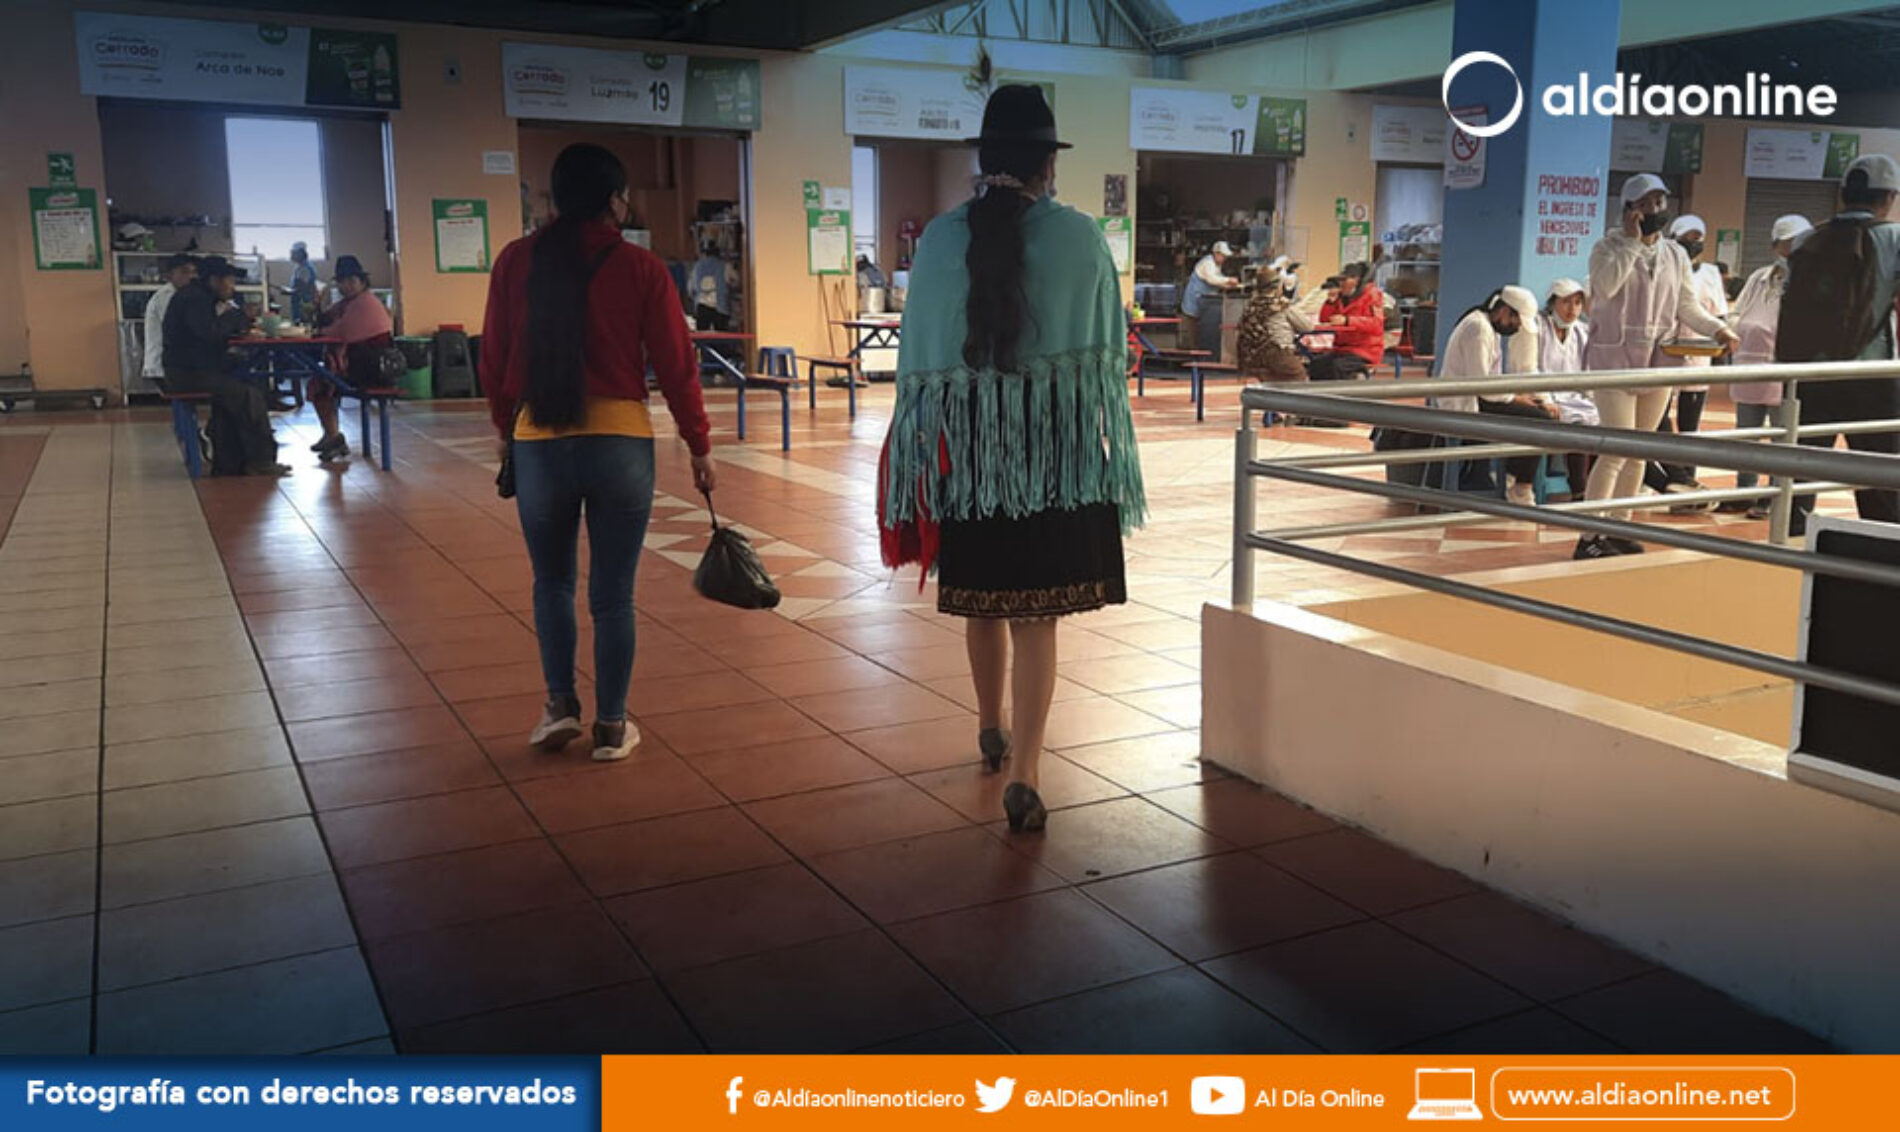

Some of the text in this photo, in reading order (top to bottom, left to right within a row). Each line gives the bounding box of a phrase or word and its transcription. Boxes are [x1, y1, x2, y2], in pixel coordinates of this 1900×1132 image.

[195, 62, 230, 74] Arca
[233, 63, 253, 74] de
[648, 80, 671, 112] 19
[1538, 174, 1599, 196] PROHIBIDO
